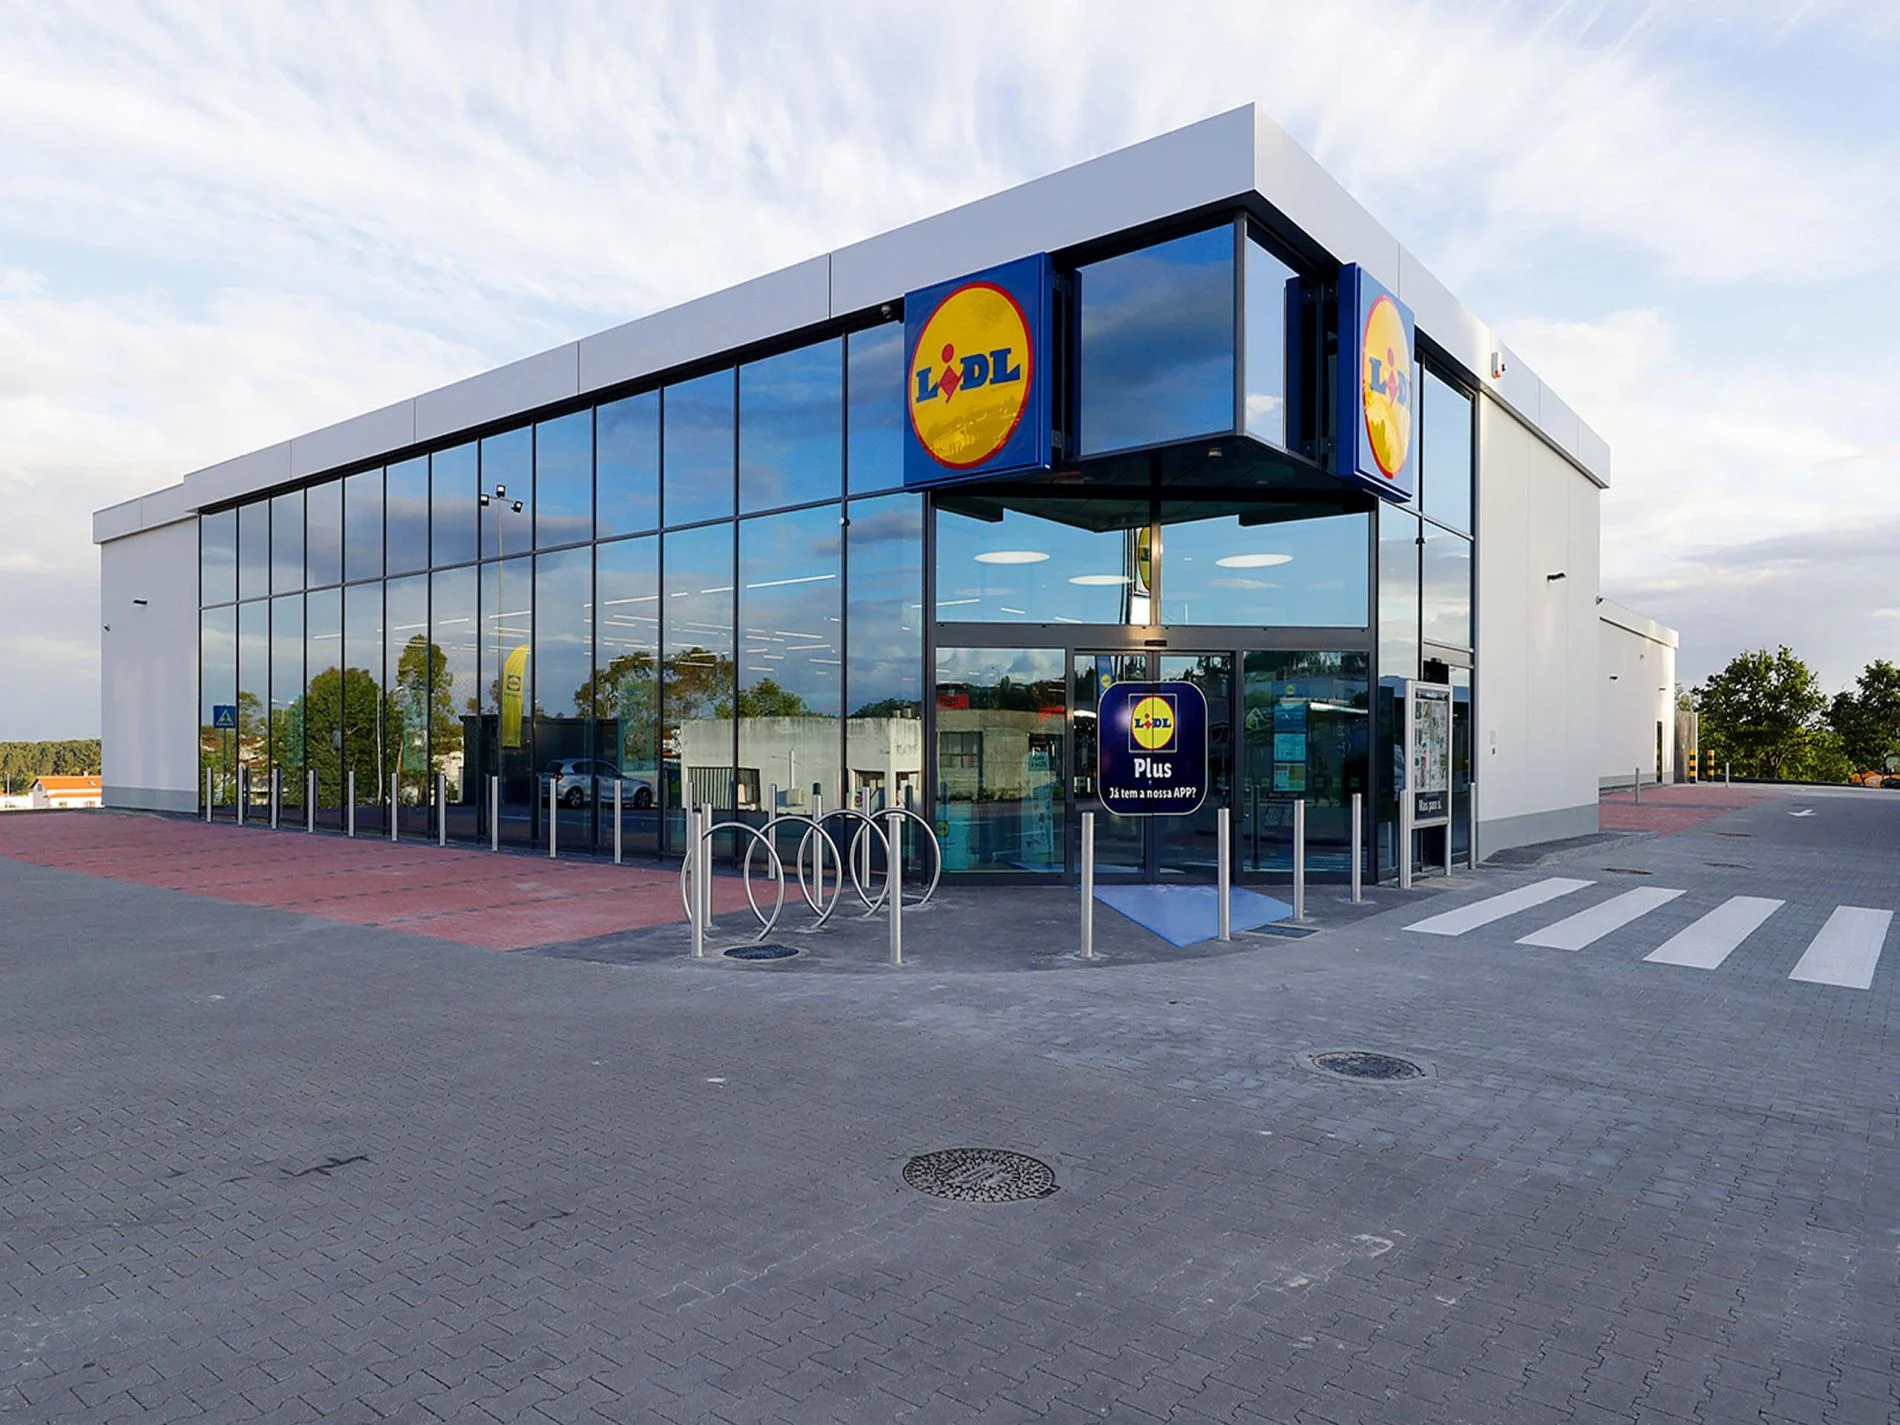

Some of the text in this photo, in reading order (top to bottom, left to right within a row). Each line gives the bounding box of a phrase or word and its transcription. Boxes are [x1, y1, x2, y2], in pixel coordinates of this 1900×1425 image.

[1134, 757, 1172, 778] Plus
[1109, 786, 1197, 799] Já tem a nossa APP?
